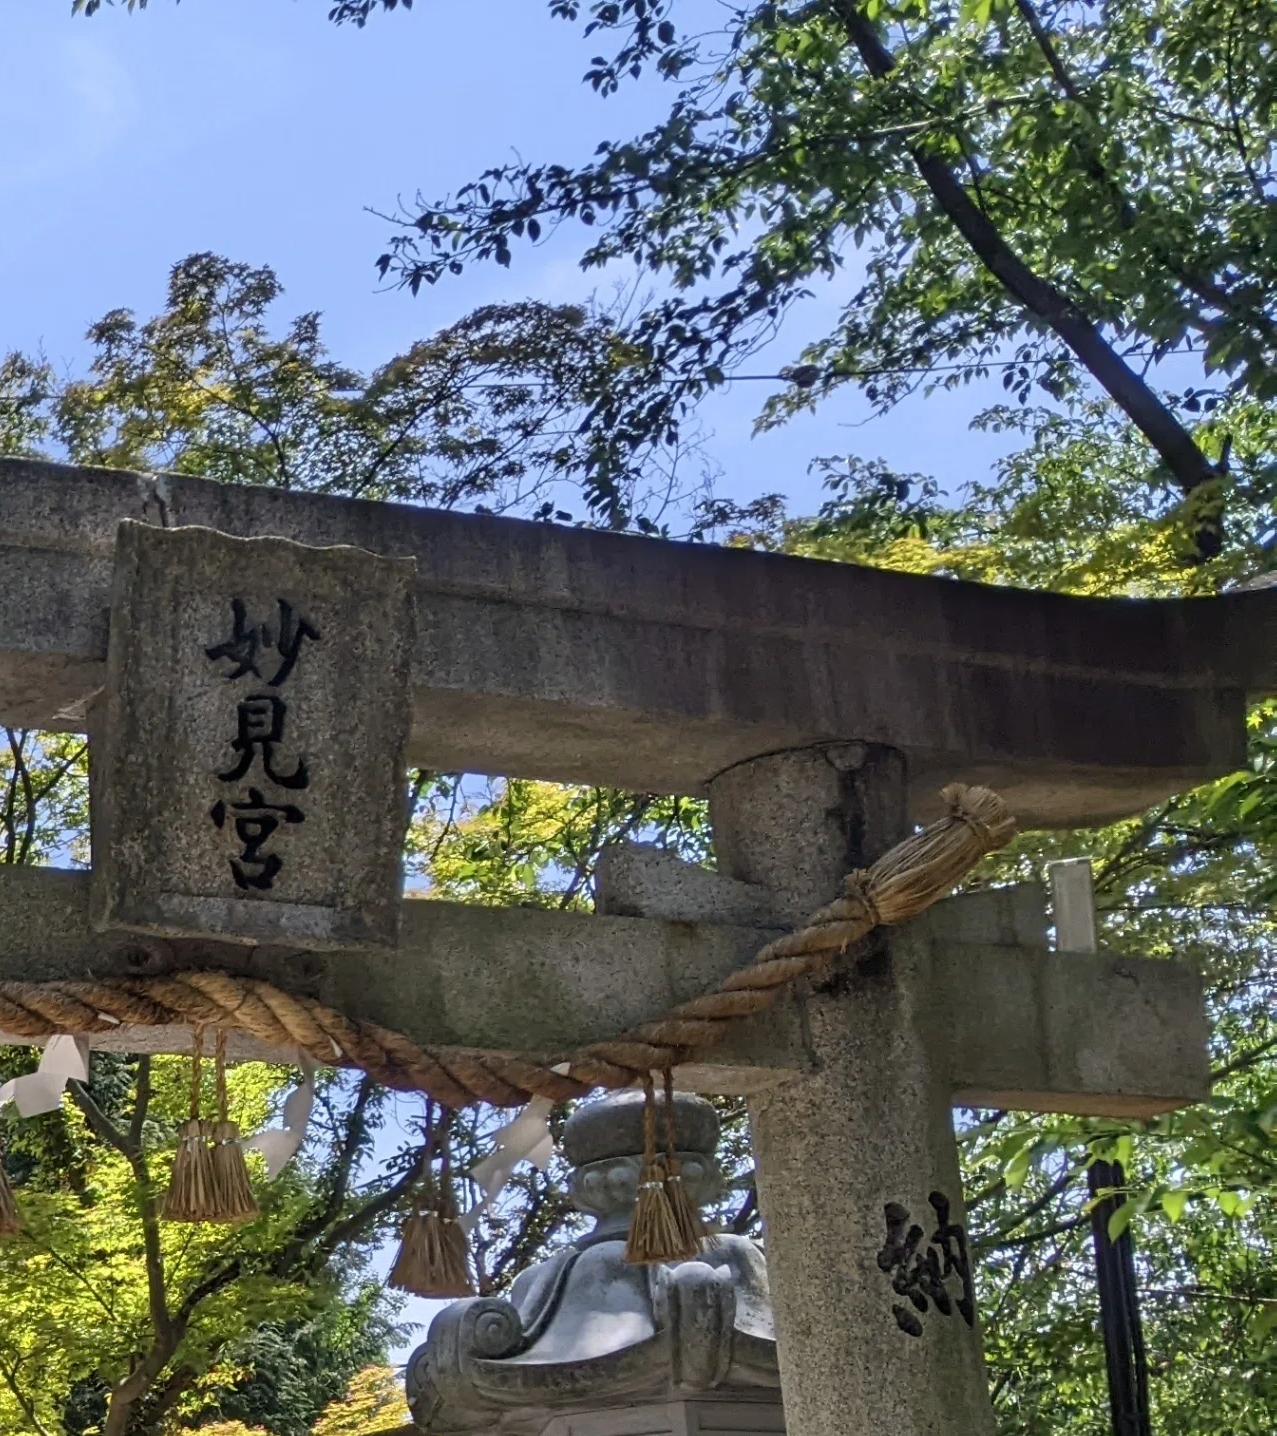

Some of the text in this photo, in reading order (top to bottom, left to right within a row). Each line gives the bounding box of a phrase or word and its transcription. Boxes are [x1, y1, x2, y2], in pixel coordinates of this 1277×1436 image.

[204, 597, 320, 891] 妙見宮
[877, 1190, 975, 1337] 納
